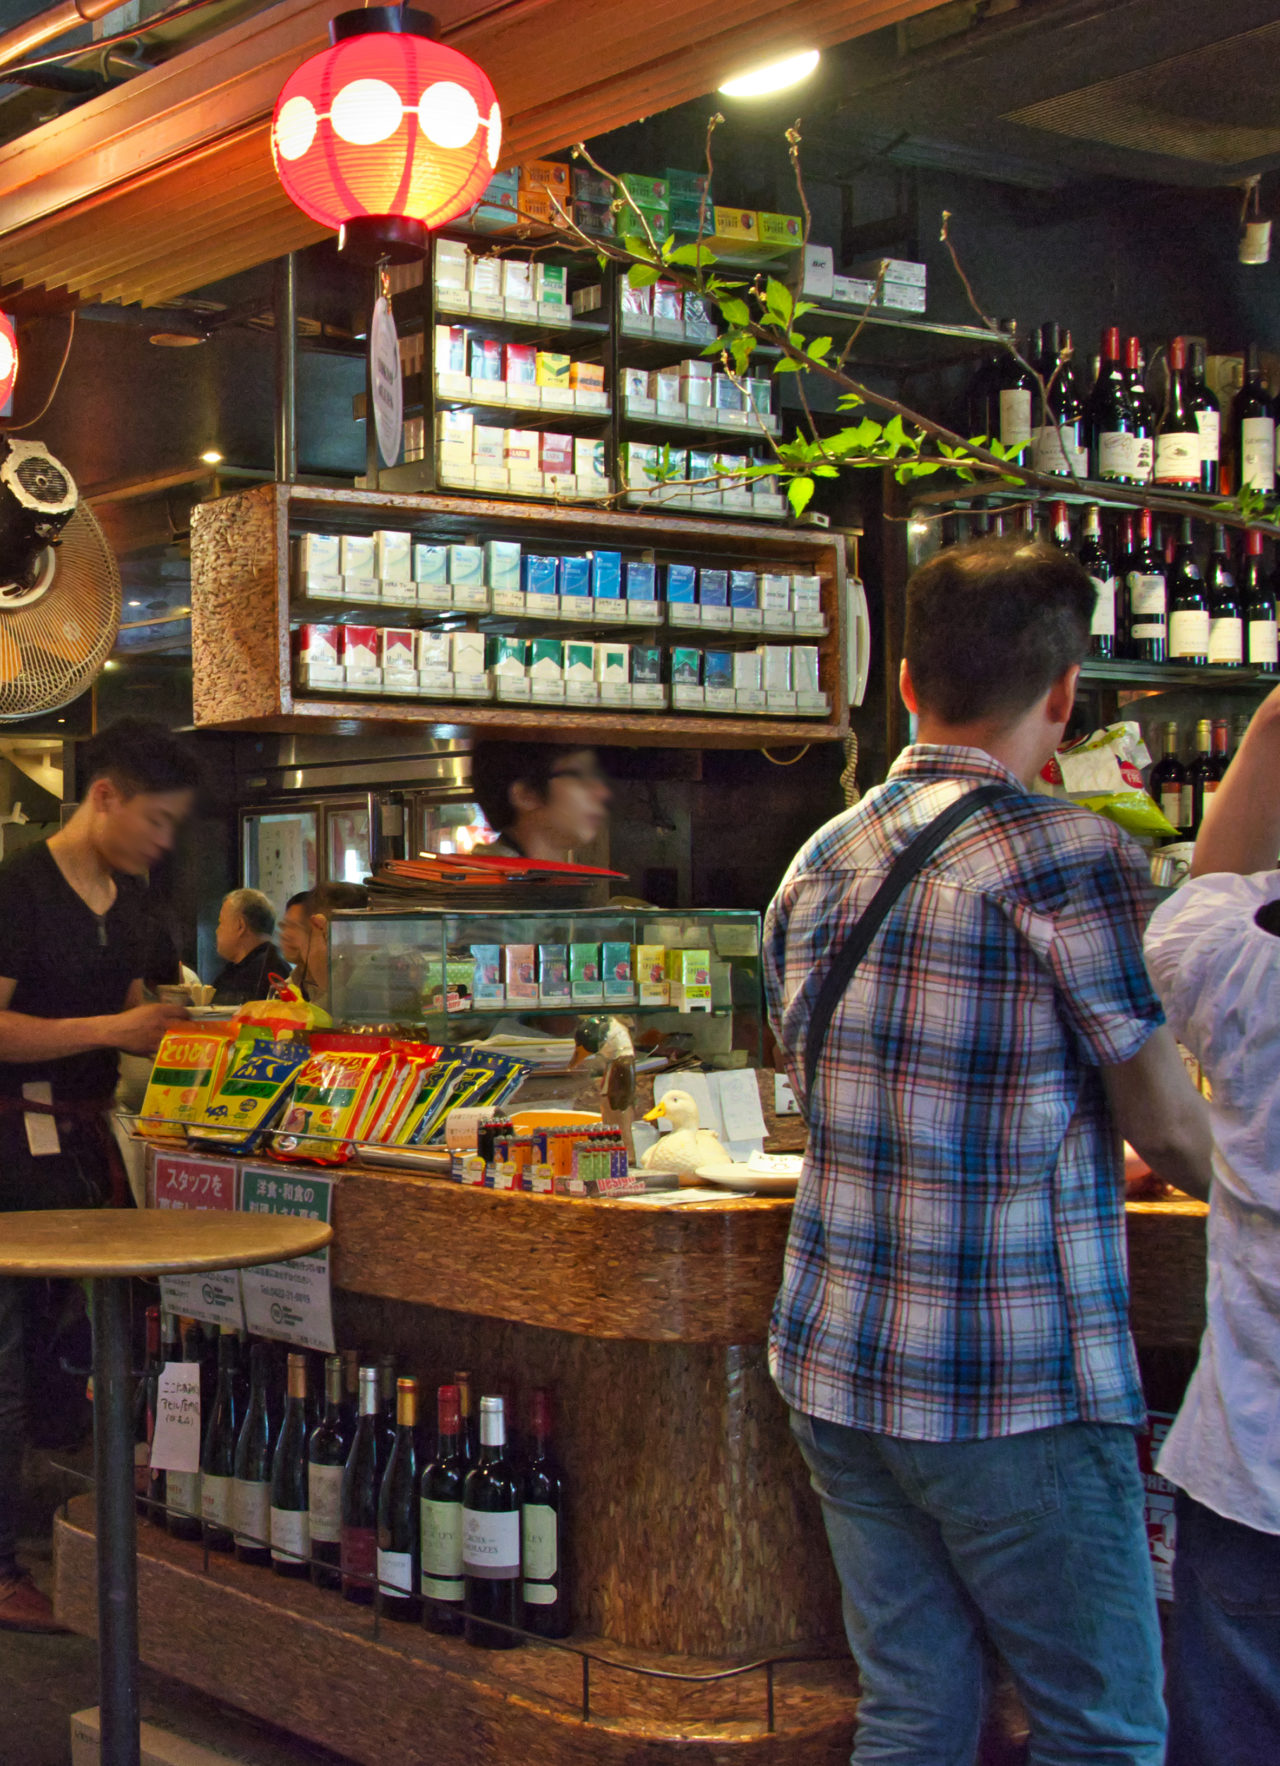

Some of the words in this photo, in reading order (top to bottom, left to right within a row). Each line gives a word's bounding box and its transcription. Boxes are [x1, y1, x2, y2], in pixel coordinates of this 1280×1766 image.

[166, 1168, 223, 1198] スタッフを
[256, 1178, 315, 1204] 洋食・和食の
